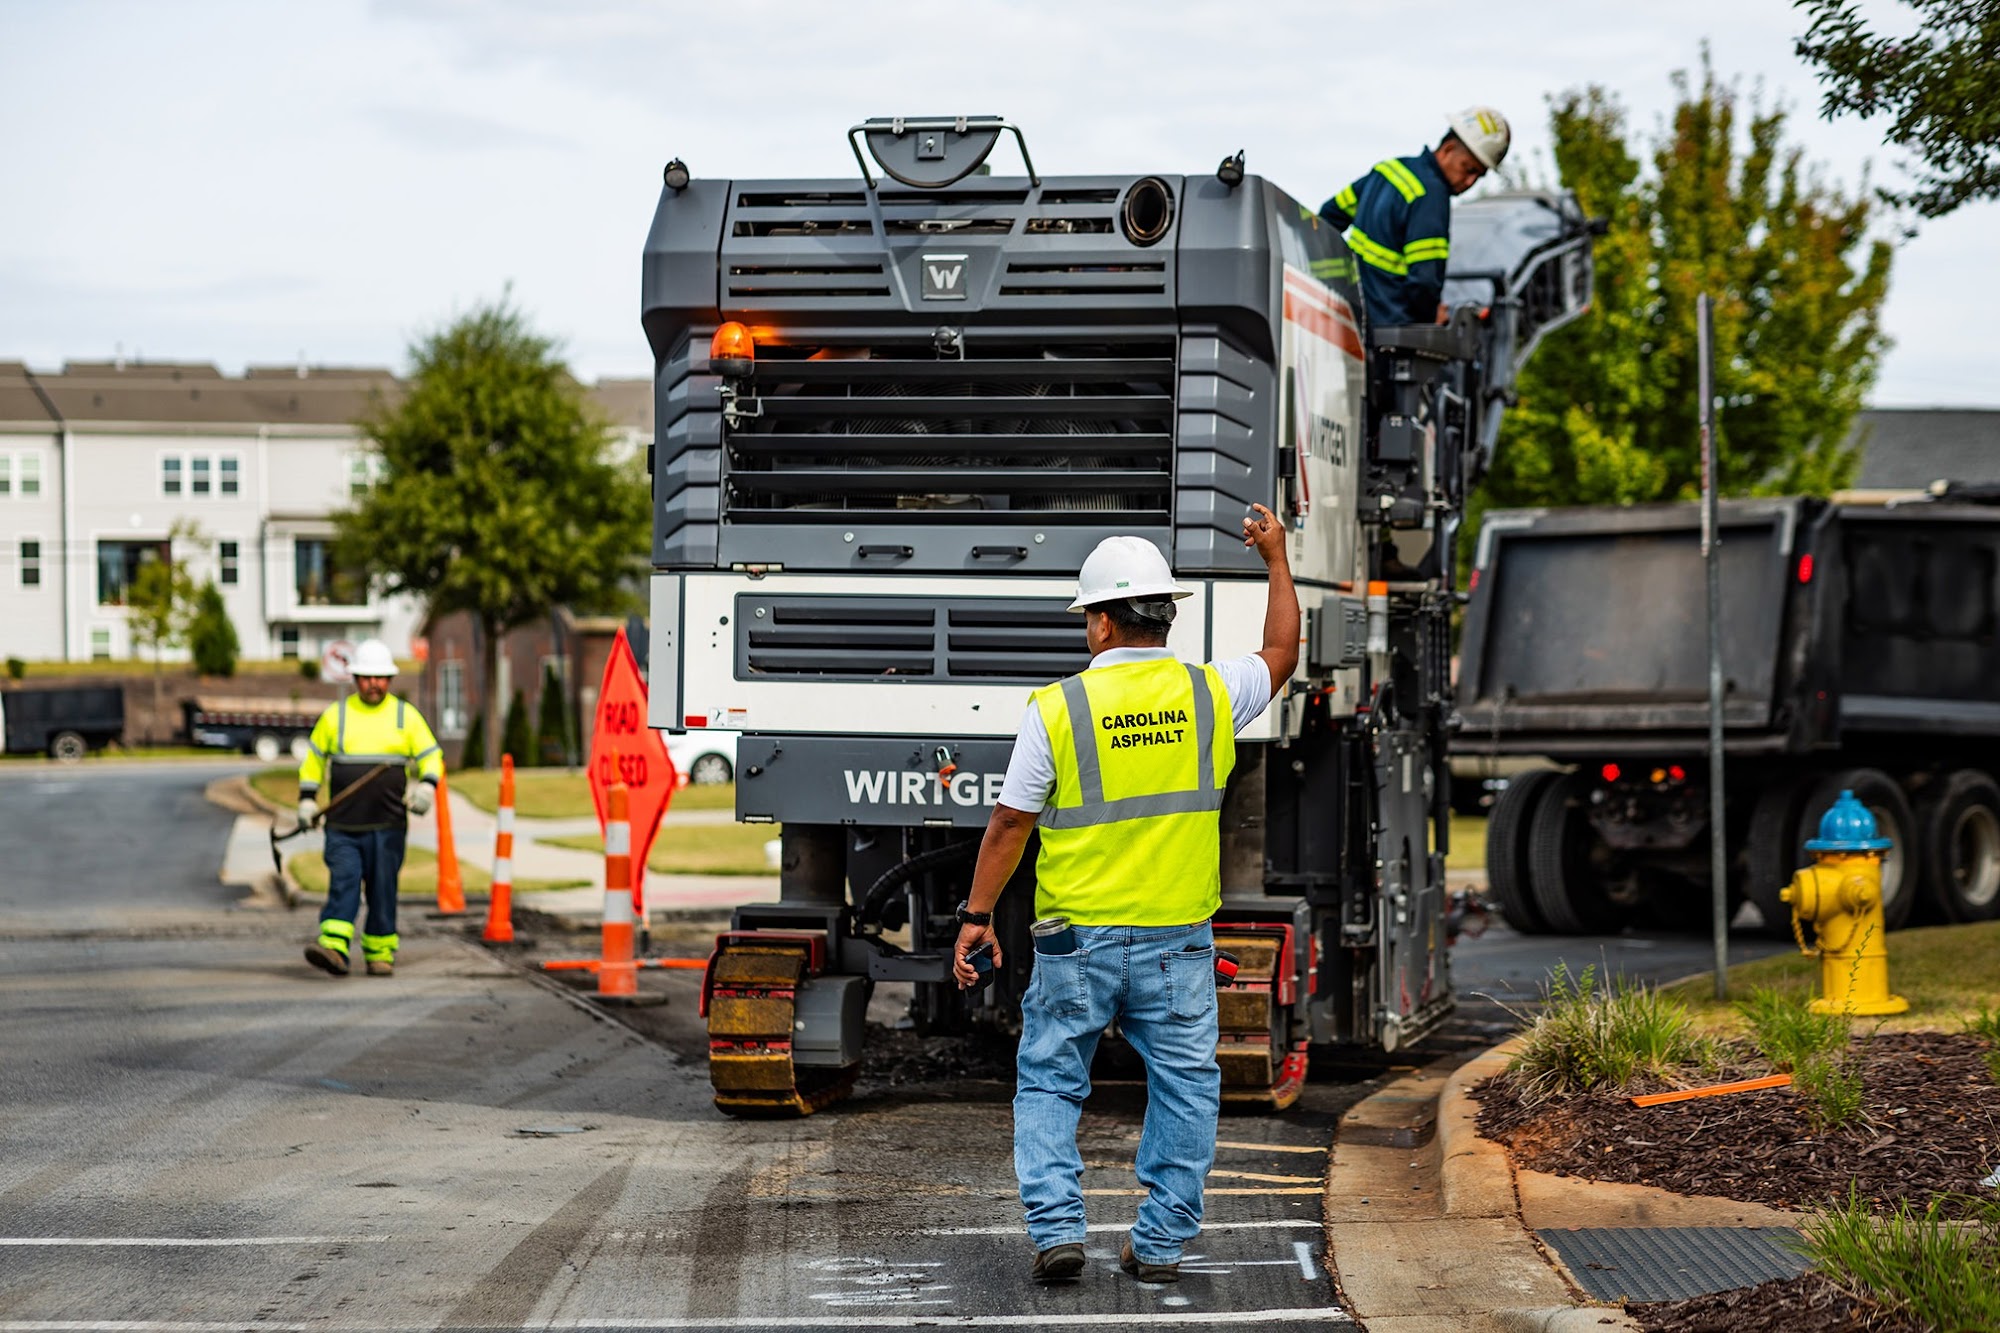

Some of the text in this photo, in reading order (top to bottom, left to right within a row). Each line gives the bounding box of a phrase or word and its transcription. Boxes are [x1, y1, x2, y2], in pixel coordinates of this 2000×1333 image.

[605, 702, 639, 734] ROAD
[1102, 710, 1188, 730] CAROLINA
[1110, 729, 1184, 749] ASPHALT
[600, 754, 648, 788] CLSED
[844, 770, 1006, 806] WIRTGE
